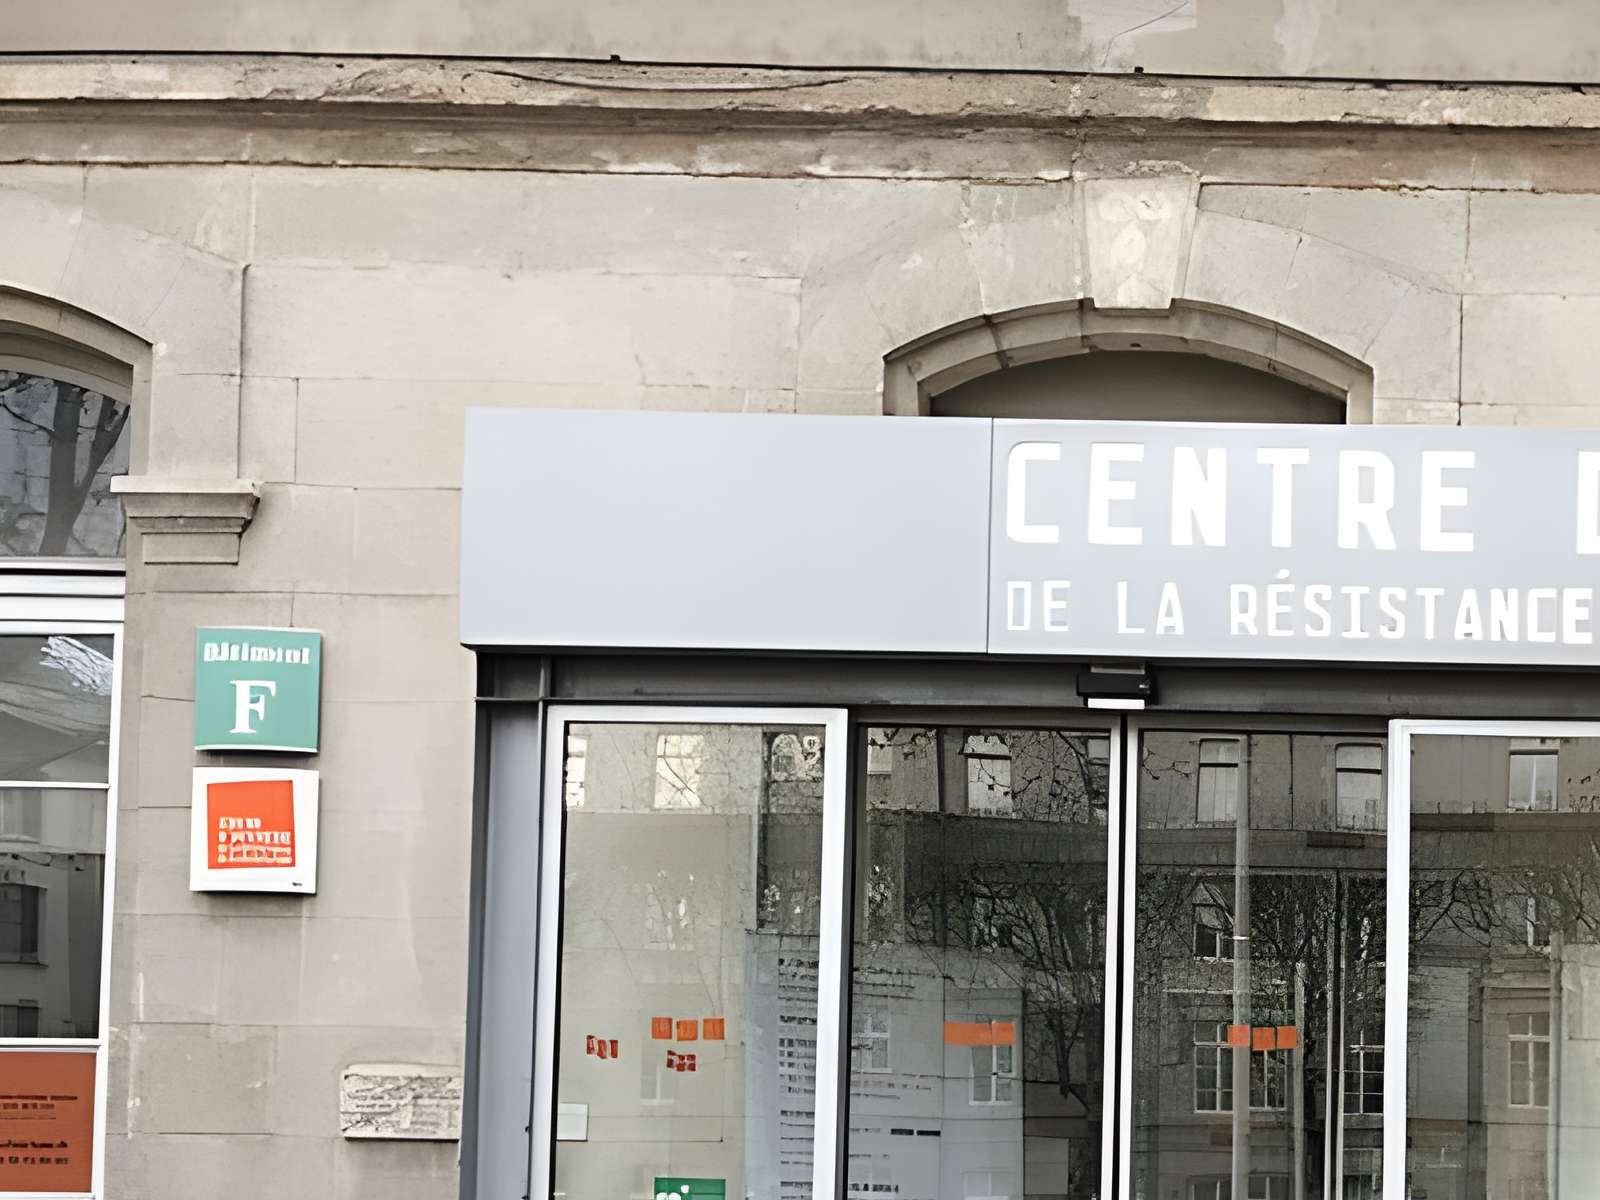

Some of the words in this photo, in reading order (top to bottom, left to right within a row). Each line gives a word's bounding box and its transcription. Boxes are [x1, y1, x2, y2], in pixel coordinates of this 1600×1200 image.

[1006, 441, 1476, 552] CENTRE
[1007, 580, 1071, 632] DE
[1117, 581, 1185, 636] LA
[1230, 569, 1593, 644] RÉSISTANCE
[228, 679, 277, 734] F
